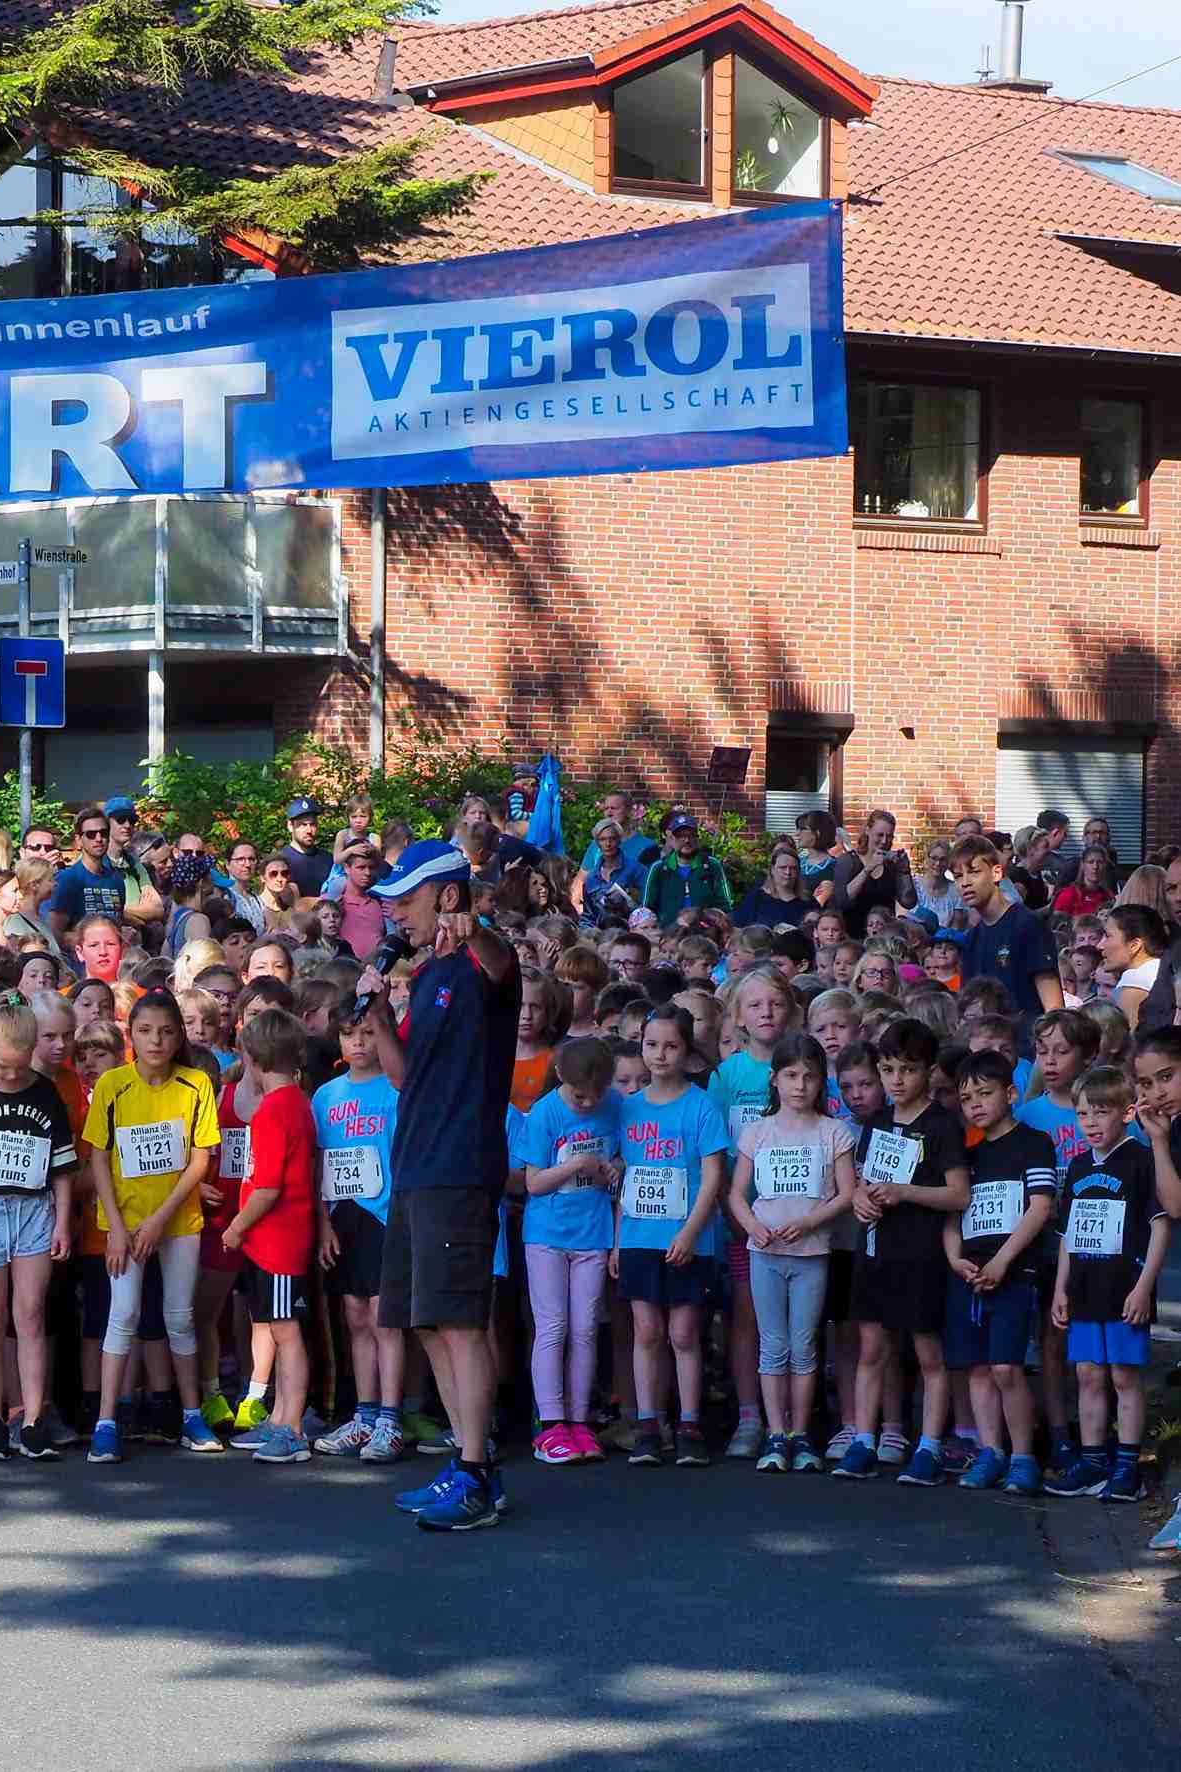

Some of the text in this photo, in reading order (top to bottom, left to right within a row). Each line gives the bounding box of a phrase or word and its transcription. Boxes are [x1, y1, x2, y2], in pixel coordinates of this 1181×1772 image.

[345, 294, 803, 404] VIEROL
[368, 383, 805, 434] AKTIENGESELLSCHAFT
[329, 1099, 359, 1121] RUN
[131, 1125, 159, 1136] Allianz
[345, 1116, 385, 1137] HES!
[135, 1140, 172, 1158] 1121
[572, 1142, 595, 1153] Allianz
[645, 1138, 683, 1160] HES!
[770, 1149, 799, 1157] Allianz
[328, 1151, 353, 1159] Allianz
[874, 1150, 900, 1169] 1149
[139, 1157, 172, 1171] bruns
[334, 1166, 360, 1180] 734
[634, 1168, 659, 1176] Allianz
[772, 1165, 810, 1179] 1123
[870, 1164, 894, 1183] bruns
[334, 1182, 364, 1195] bruns
[639, 1186, 666, 1199] 694
[774, 1180, 807, 1193] bruns
[635, 1200, 667, 1214] bruns
[971, 1200, 1003, 1217] 2131
[972, 1218, 1003, 1231] bruns
[1075, 1219, 1105, 1234] 1471
[1075, 1234, 1102, 1249] bruns
